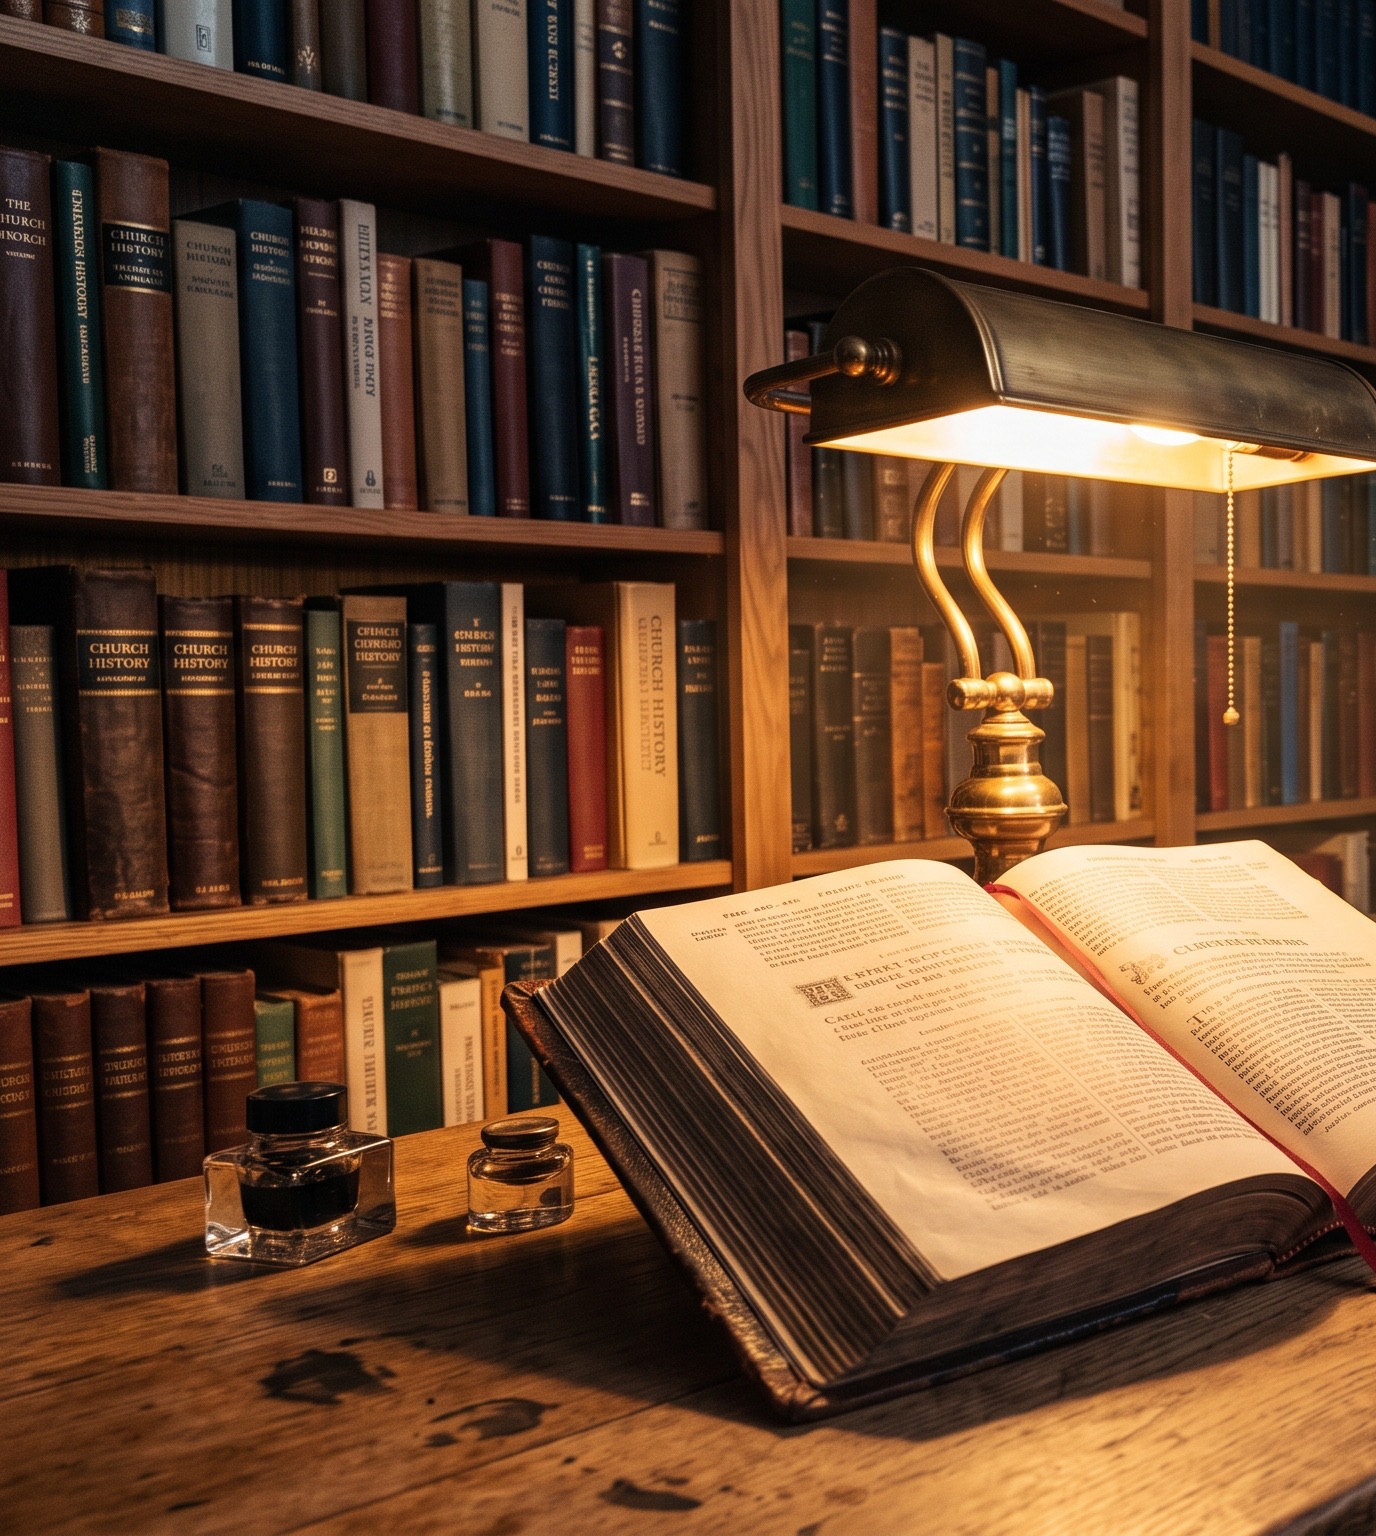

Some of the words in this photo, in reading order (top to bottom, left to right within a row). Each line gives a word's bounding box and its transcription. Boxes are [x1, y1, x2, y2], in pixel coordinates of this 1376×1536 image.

[5, 198, 31, 211] THE
[89, 643, 149, 654] CHURCH
[174, 644, 228, 655] CHURCH
[652, 616, 664, 692] CHURCH
[89, 658, 150, 669] HISTORY
[173, 658, 229, 669] HISTORY
[653, 699, 666, 777] HISTORY
